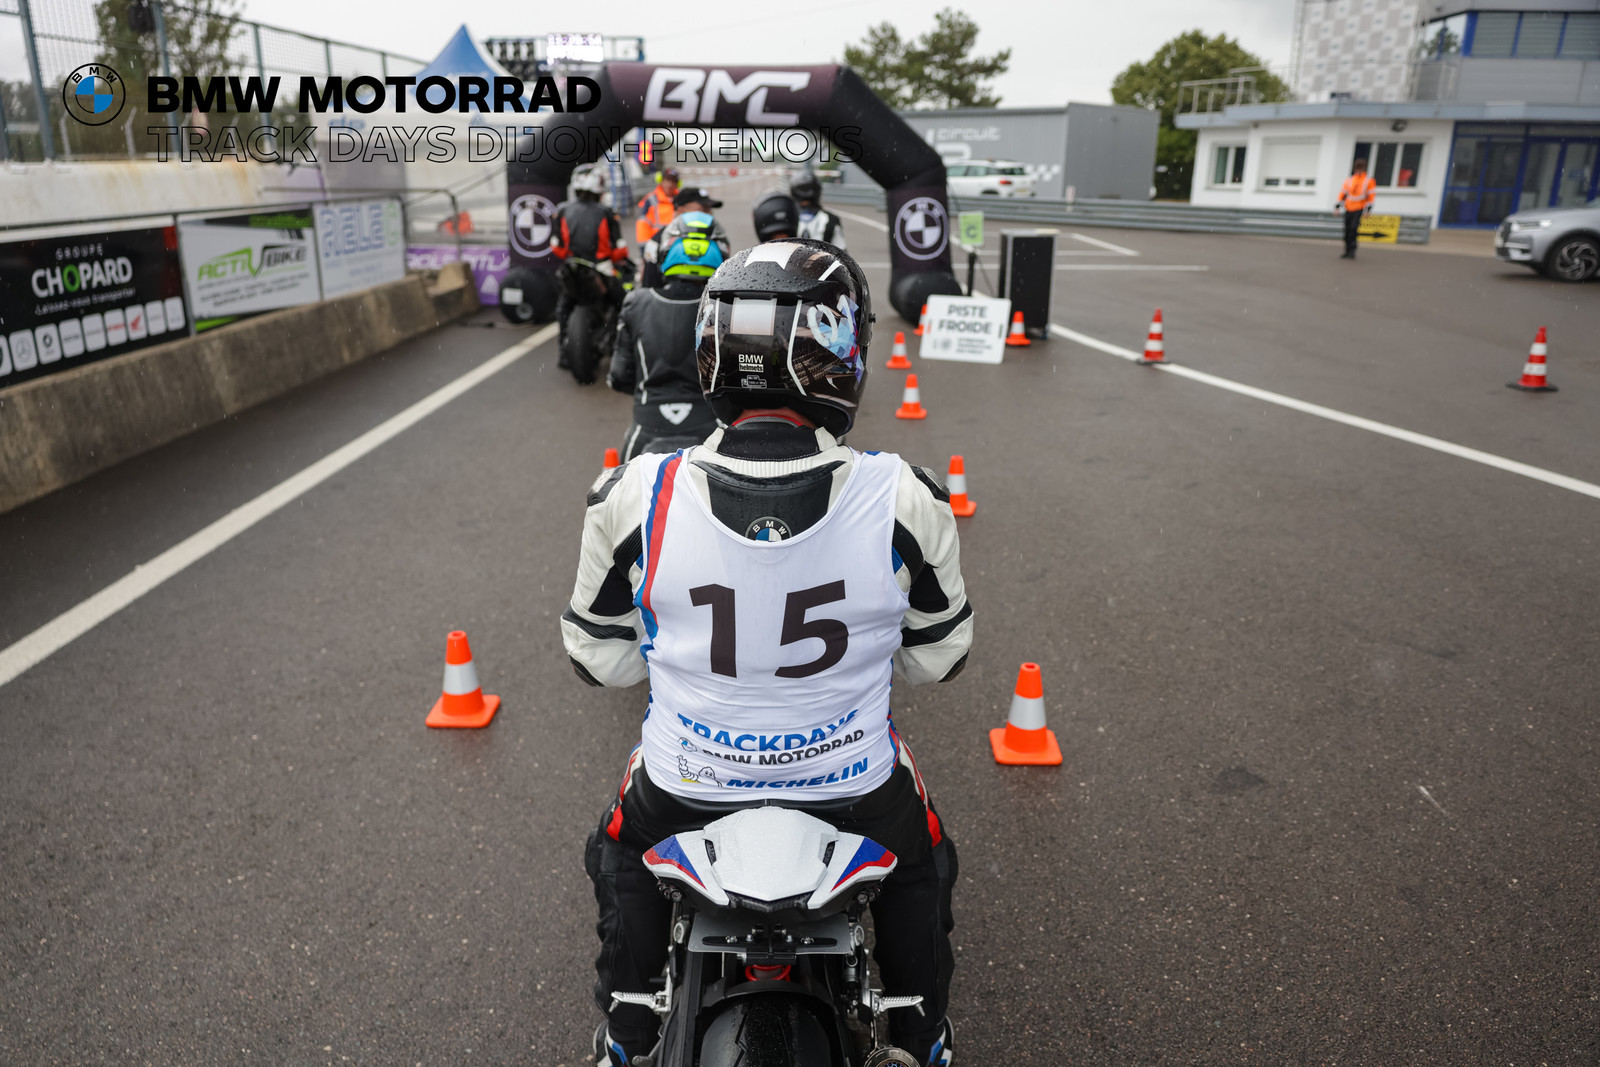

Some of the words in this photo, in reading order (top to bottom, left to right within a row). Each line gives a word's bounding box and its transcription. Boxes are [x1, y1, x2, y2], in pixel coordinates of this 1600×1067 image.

[643, 67, 812, 126] BMC
[965, 225, 978, 239] C
[55, 244, 104, 261] GROUPE
[31, 256, 133, 298] CHOPARD
[947, 304, 987, 319] PISTE
[938, 319, 992, 335] FROIDE
[738, 353, 764, 364] BMW
[739, 363, 764, 373] helmets
[752, 520, 787, 535] BMW
[689, 580, 849, 679] 15
[759, 729, 864, 766] MOTORRAD
[726, 756, 868, 789] MICHELIN
